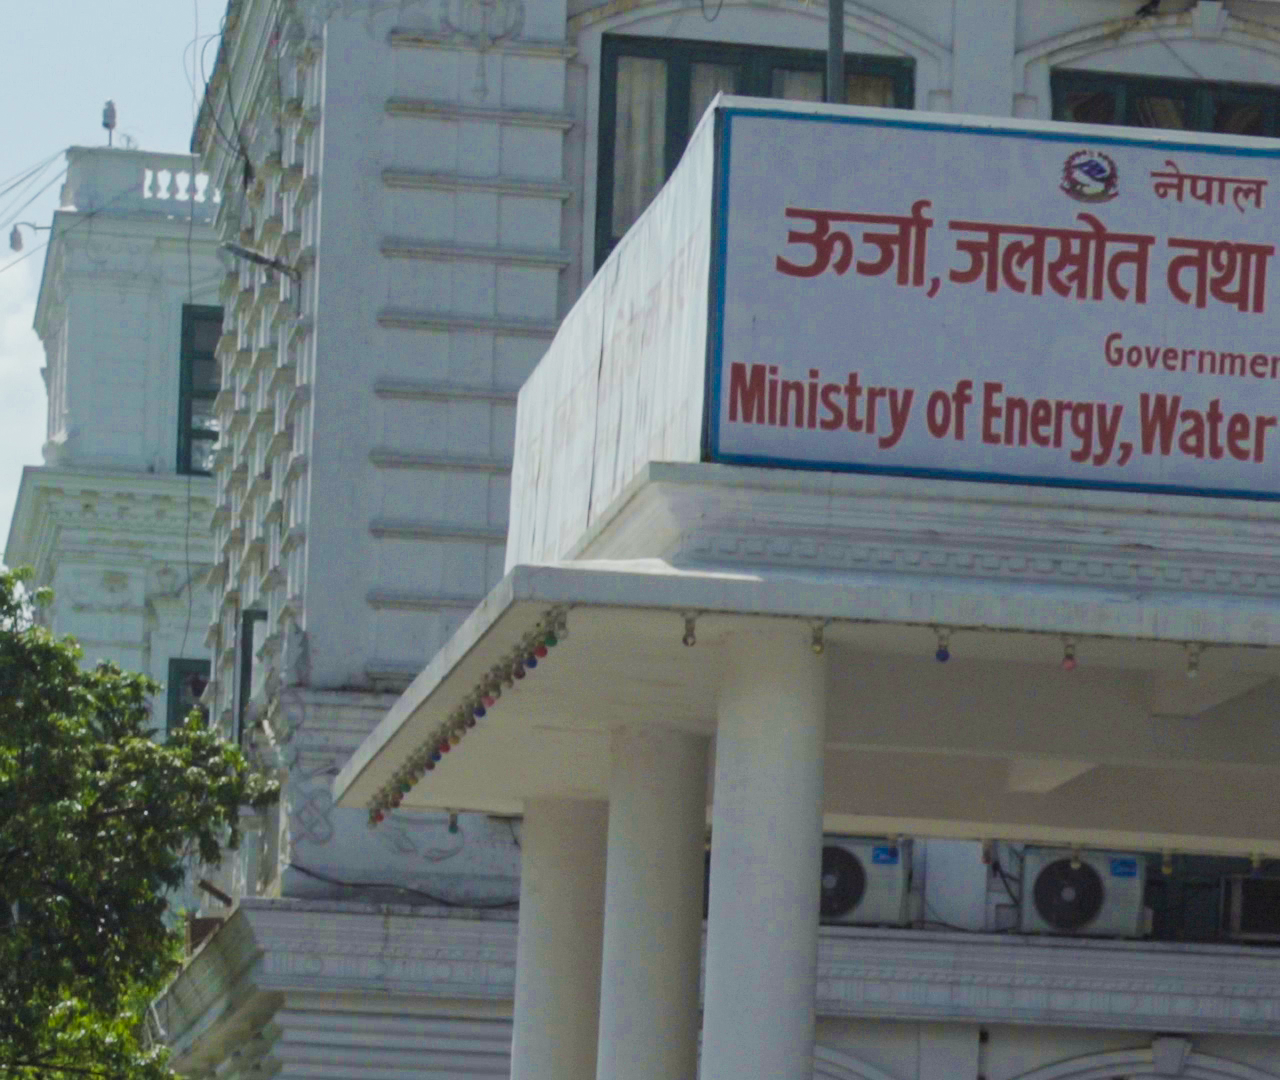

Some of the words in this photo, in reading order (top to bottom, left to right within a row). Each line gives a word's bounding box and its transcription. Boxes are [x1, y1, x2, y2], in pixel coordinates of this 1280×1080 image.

[1150, 160, 1267, 213] नेपाल
[1166, 237, 1274, 314] तथा
[728, 361, 913, 450] Ministry
[926, 380, 973, 441] of
